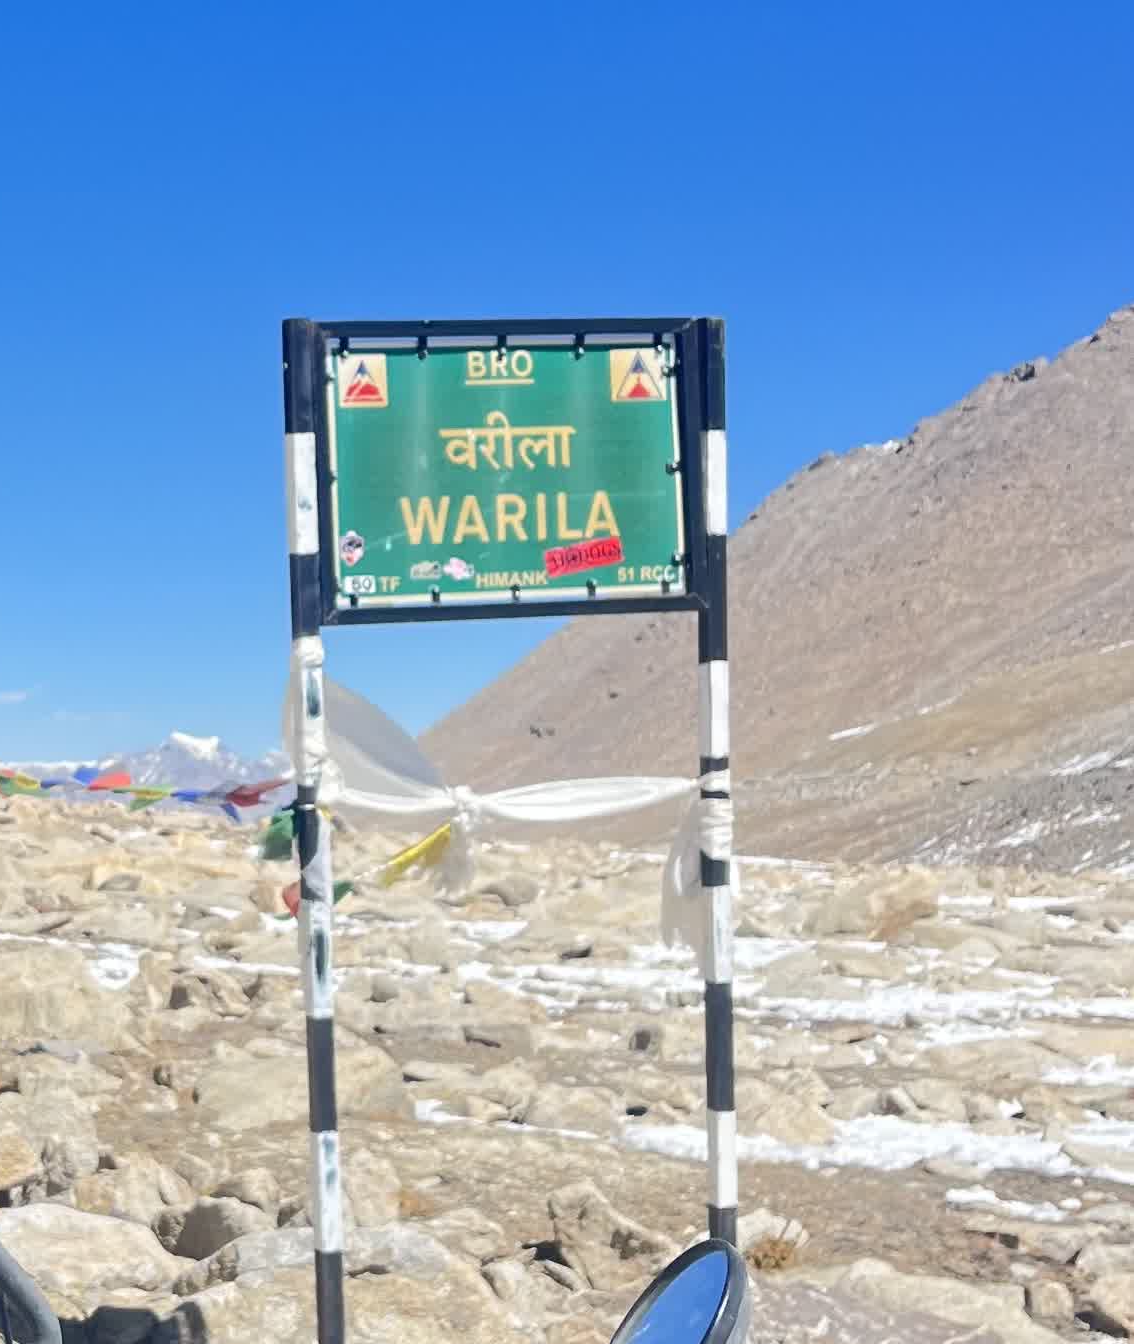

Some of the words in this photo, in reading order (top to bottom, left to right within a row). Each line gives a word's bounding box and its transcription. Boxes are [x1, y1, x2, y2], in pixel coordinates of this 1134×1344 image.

[466, 350, 534, 378] BRO
[439, 410, 577, 470] वरीला
[401, 490, 621, 545] WARILA
[379, 576, 402, 592] TF
[475, 570, 549, 588] HIMANK
[641, 564, 676, 581] RCC
